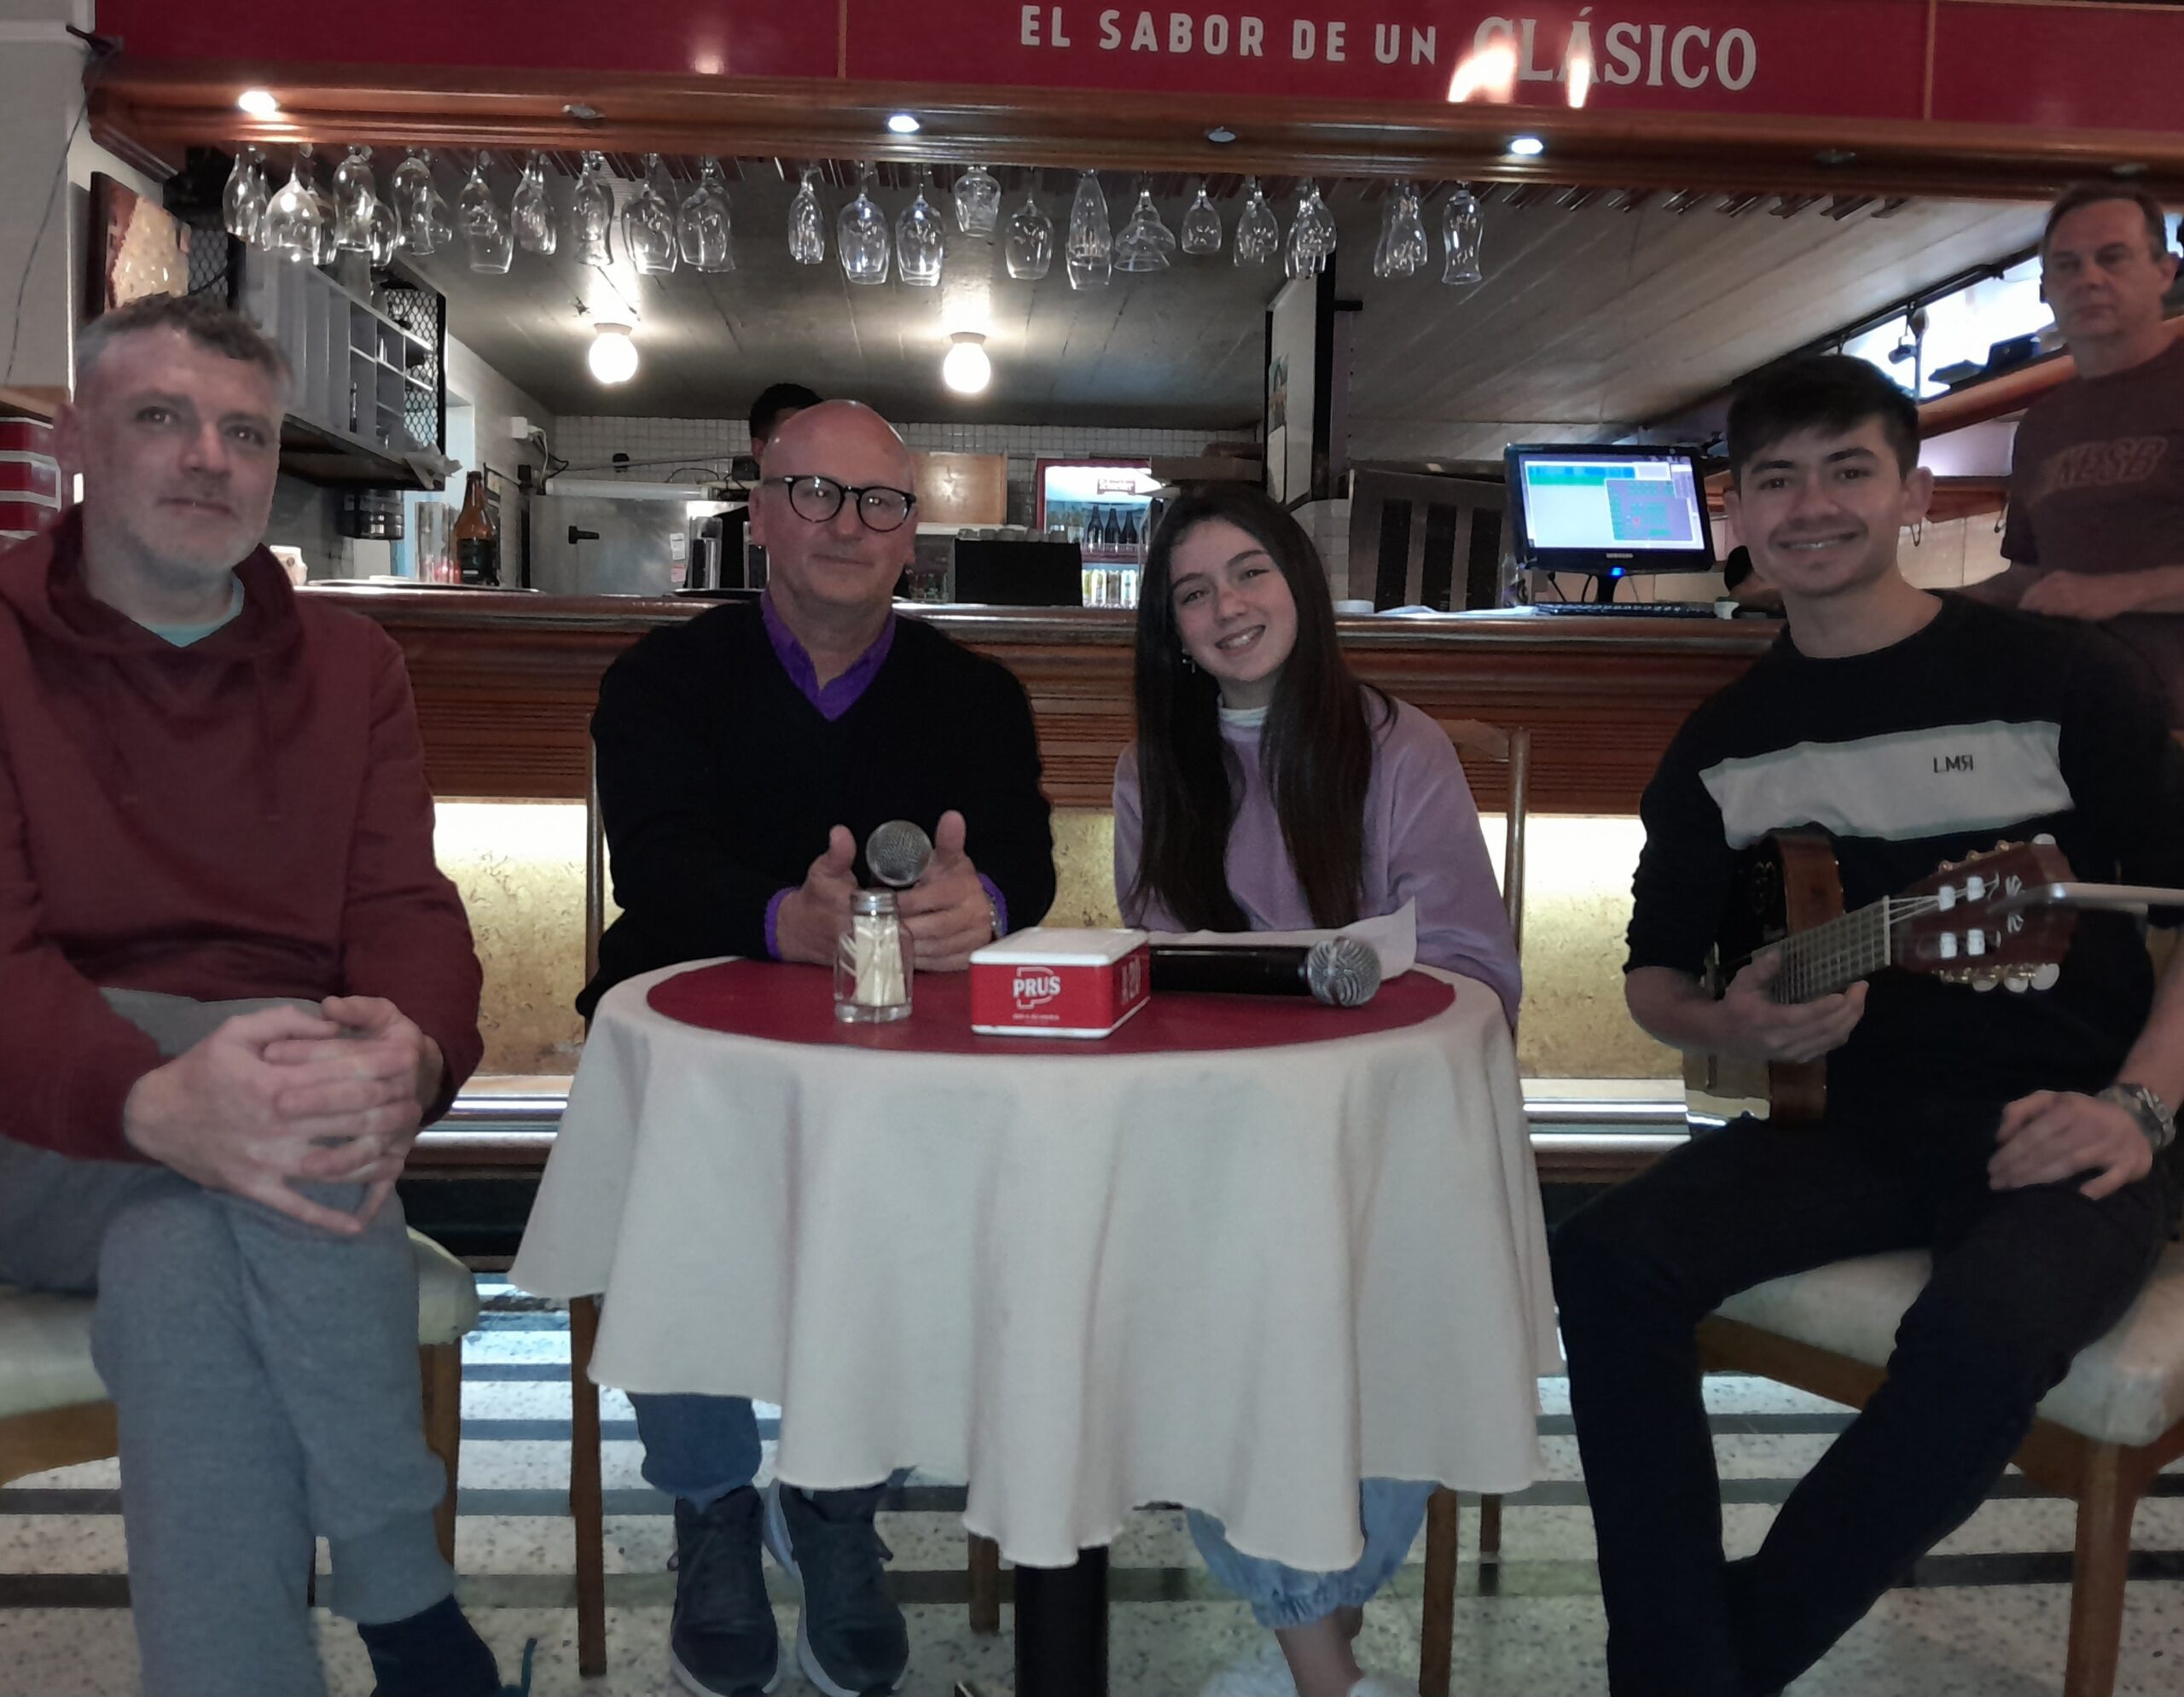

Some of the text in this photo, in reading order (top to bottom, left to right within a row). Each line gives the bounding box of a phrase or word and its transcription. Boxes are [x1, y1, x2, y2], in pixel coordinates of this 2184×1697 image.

[1021, 5, 1071, 47] EL
[1099, 9, 1264, 56] SABOR
[1292, 19, 1346, 61] DE
[1374, 23, 1436, 65] UN
[1013, 975, 1061, 997] PRUS
